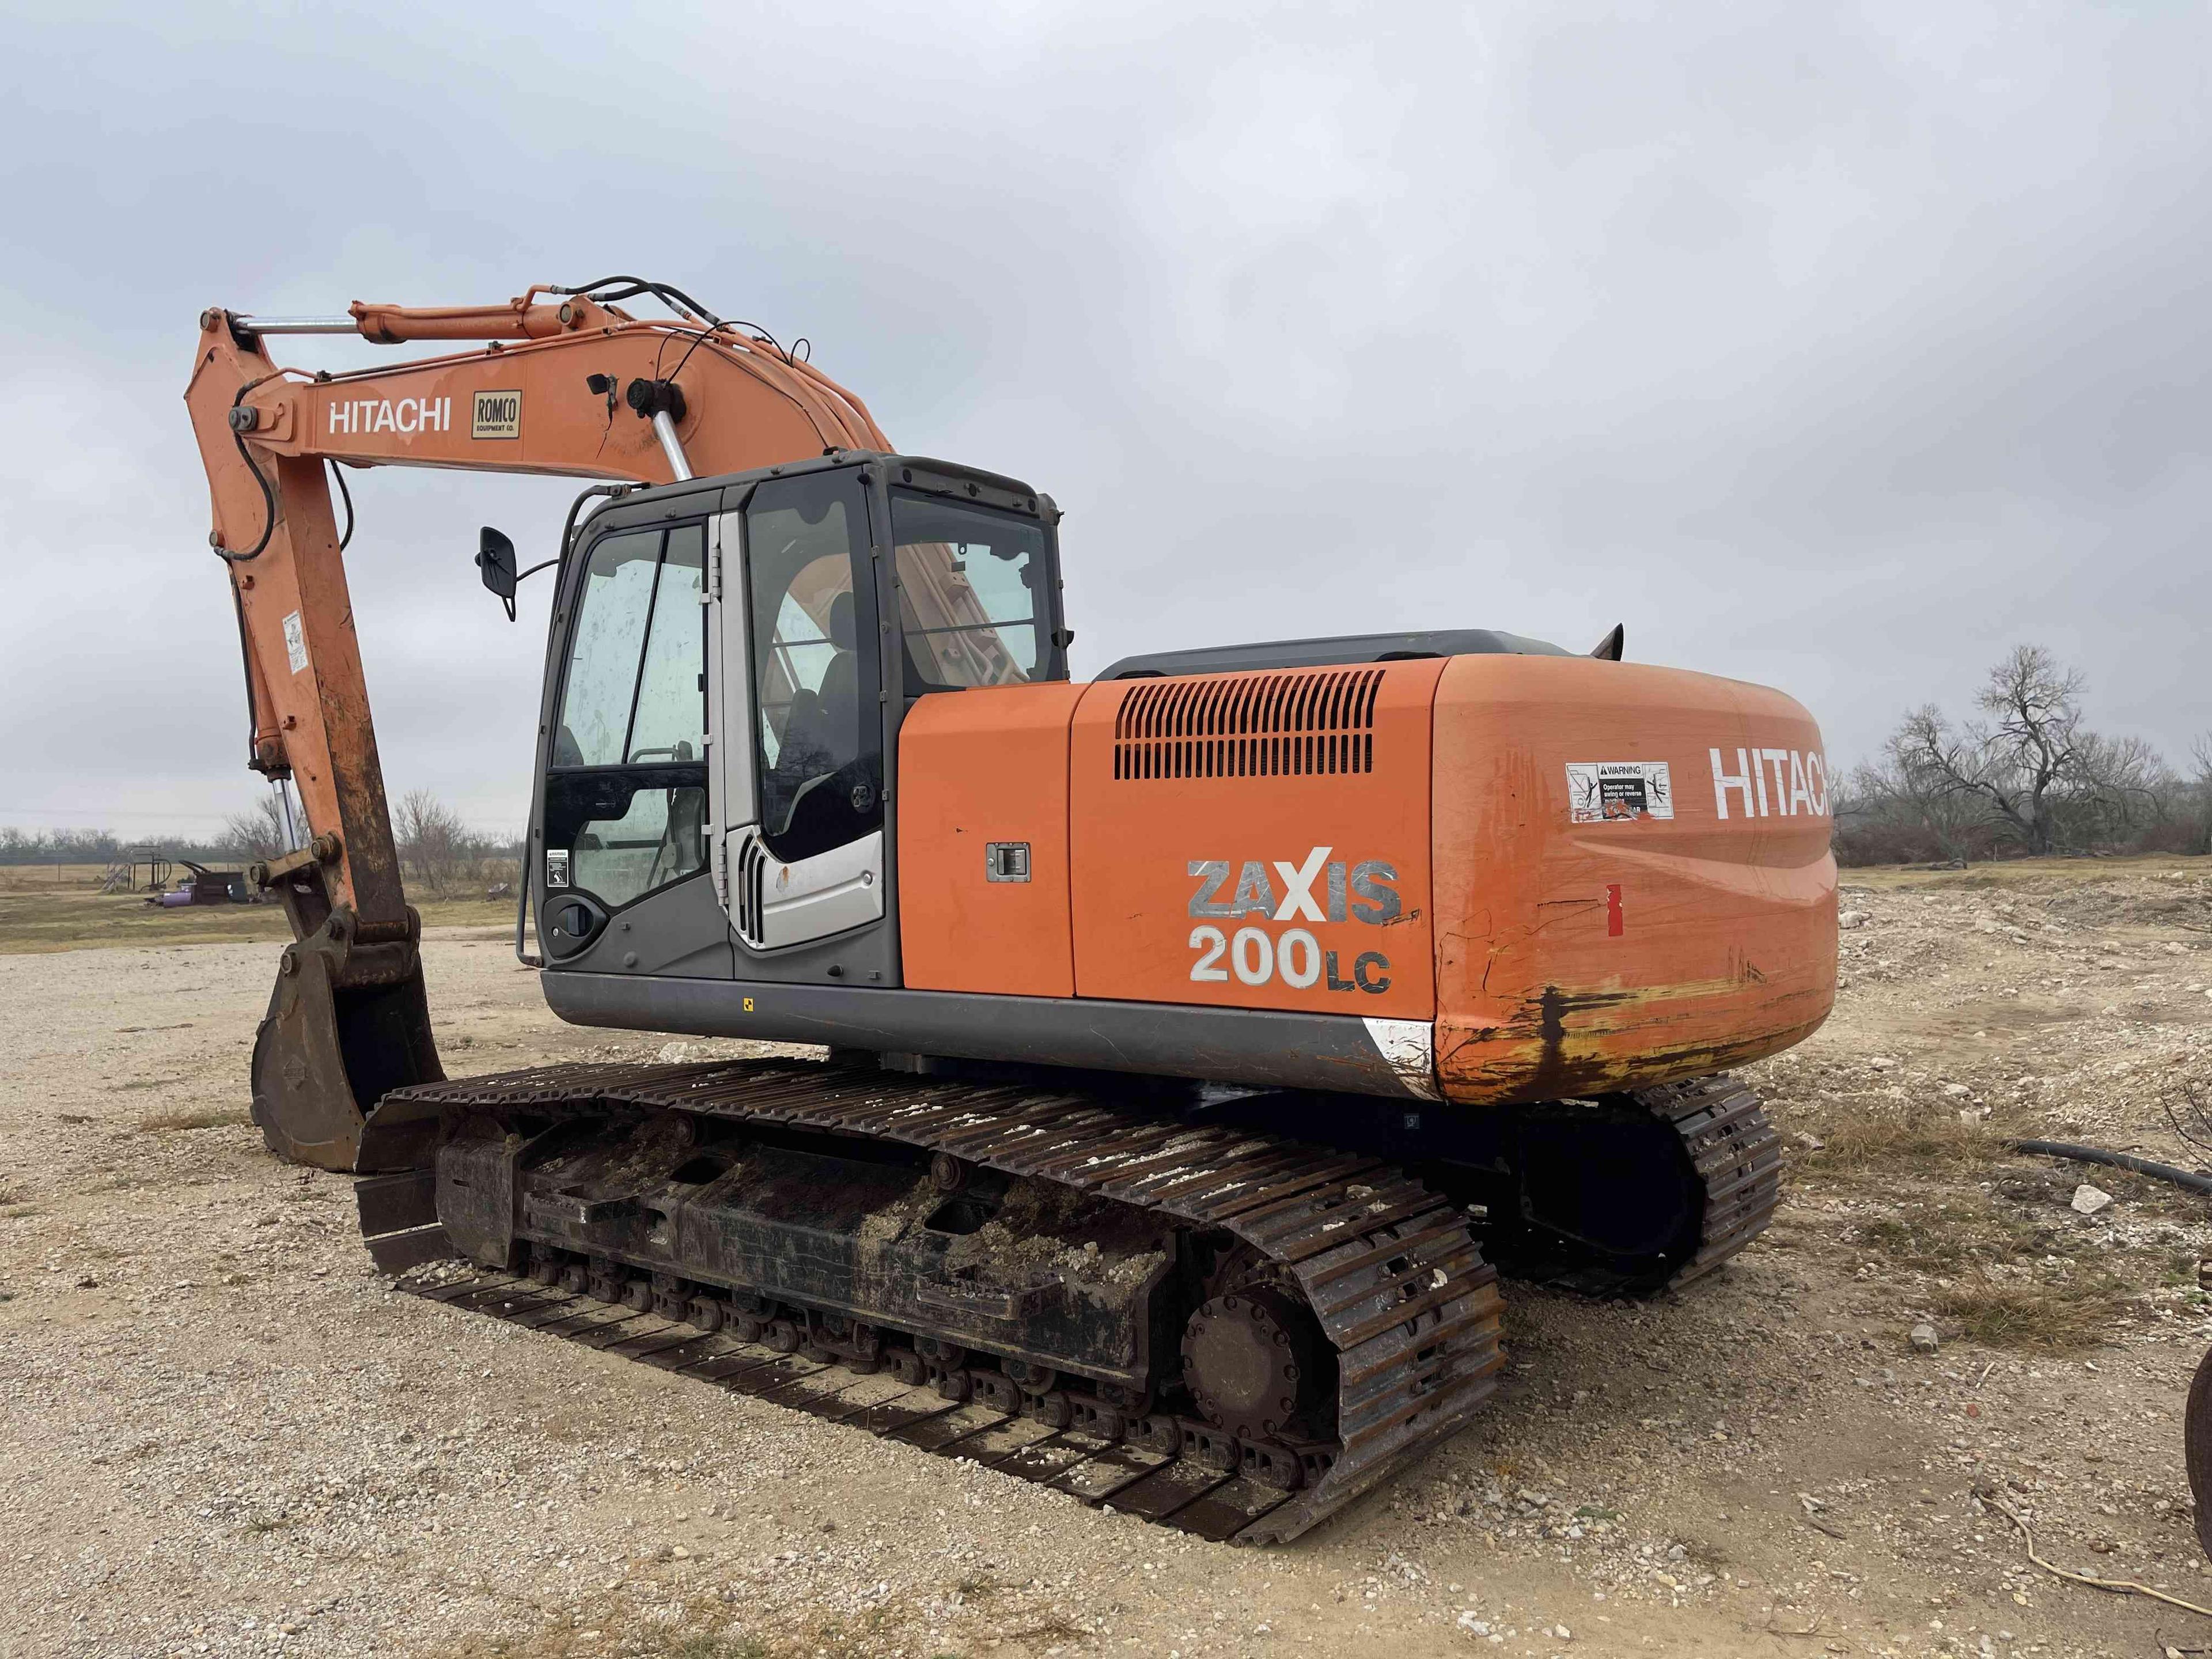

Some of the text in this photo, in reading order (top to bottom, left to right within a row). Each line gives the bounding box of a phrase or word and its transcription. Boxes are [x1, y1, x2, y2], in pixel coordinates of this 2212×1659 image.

[329, 397, 450, 433] HITACHI
[478, 398, 516, 422] ROMCO
[1608, 766, 1641, 775] WARNING
[1709, 748, 1834, 819] HITACH
[1188, 847, 1402, 925] ZAXIS
